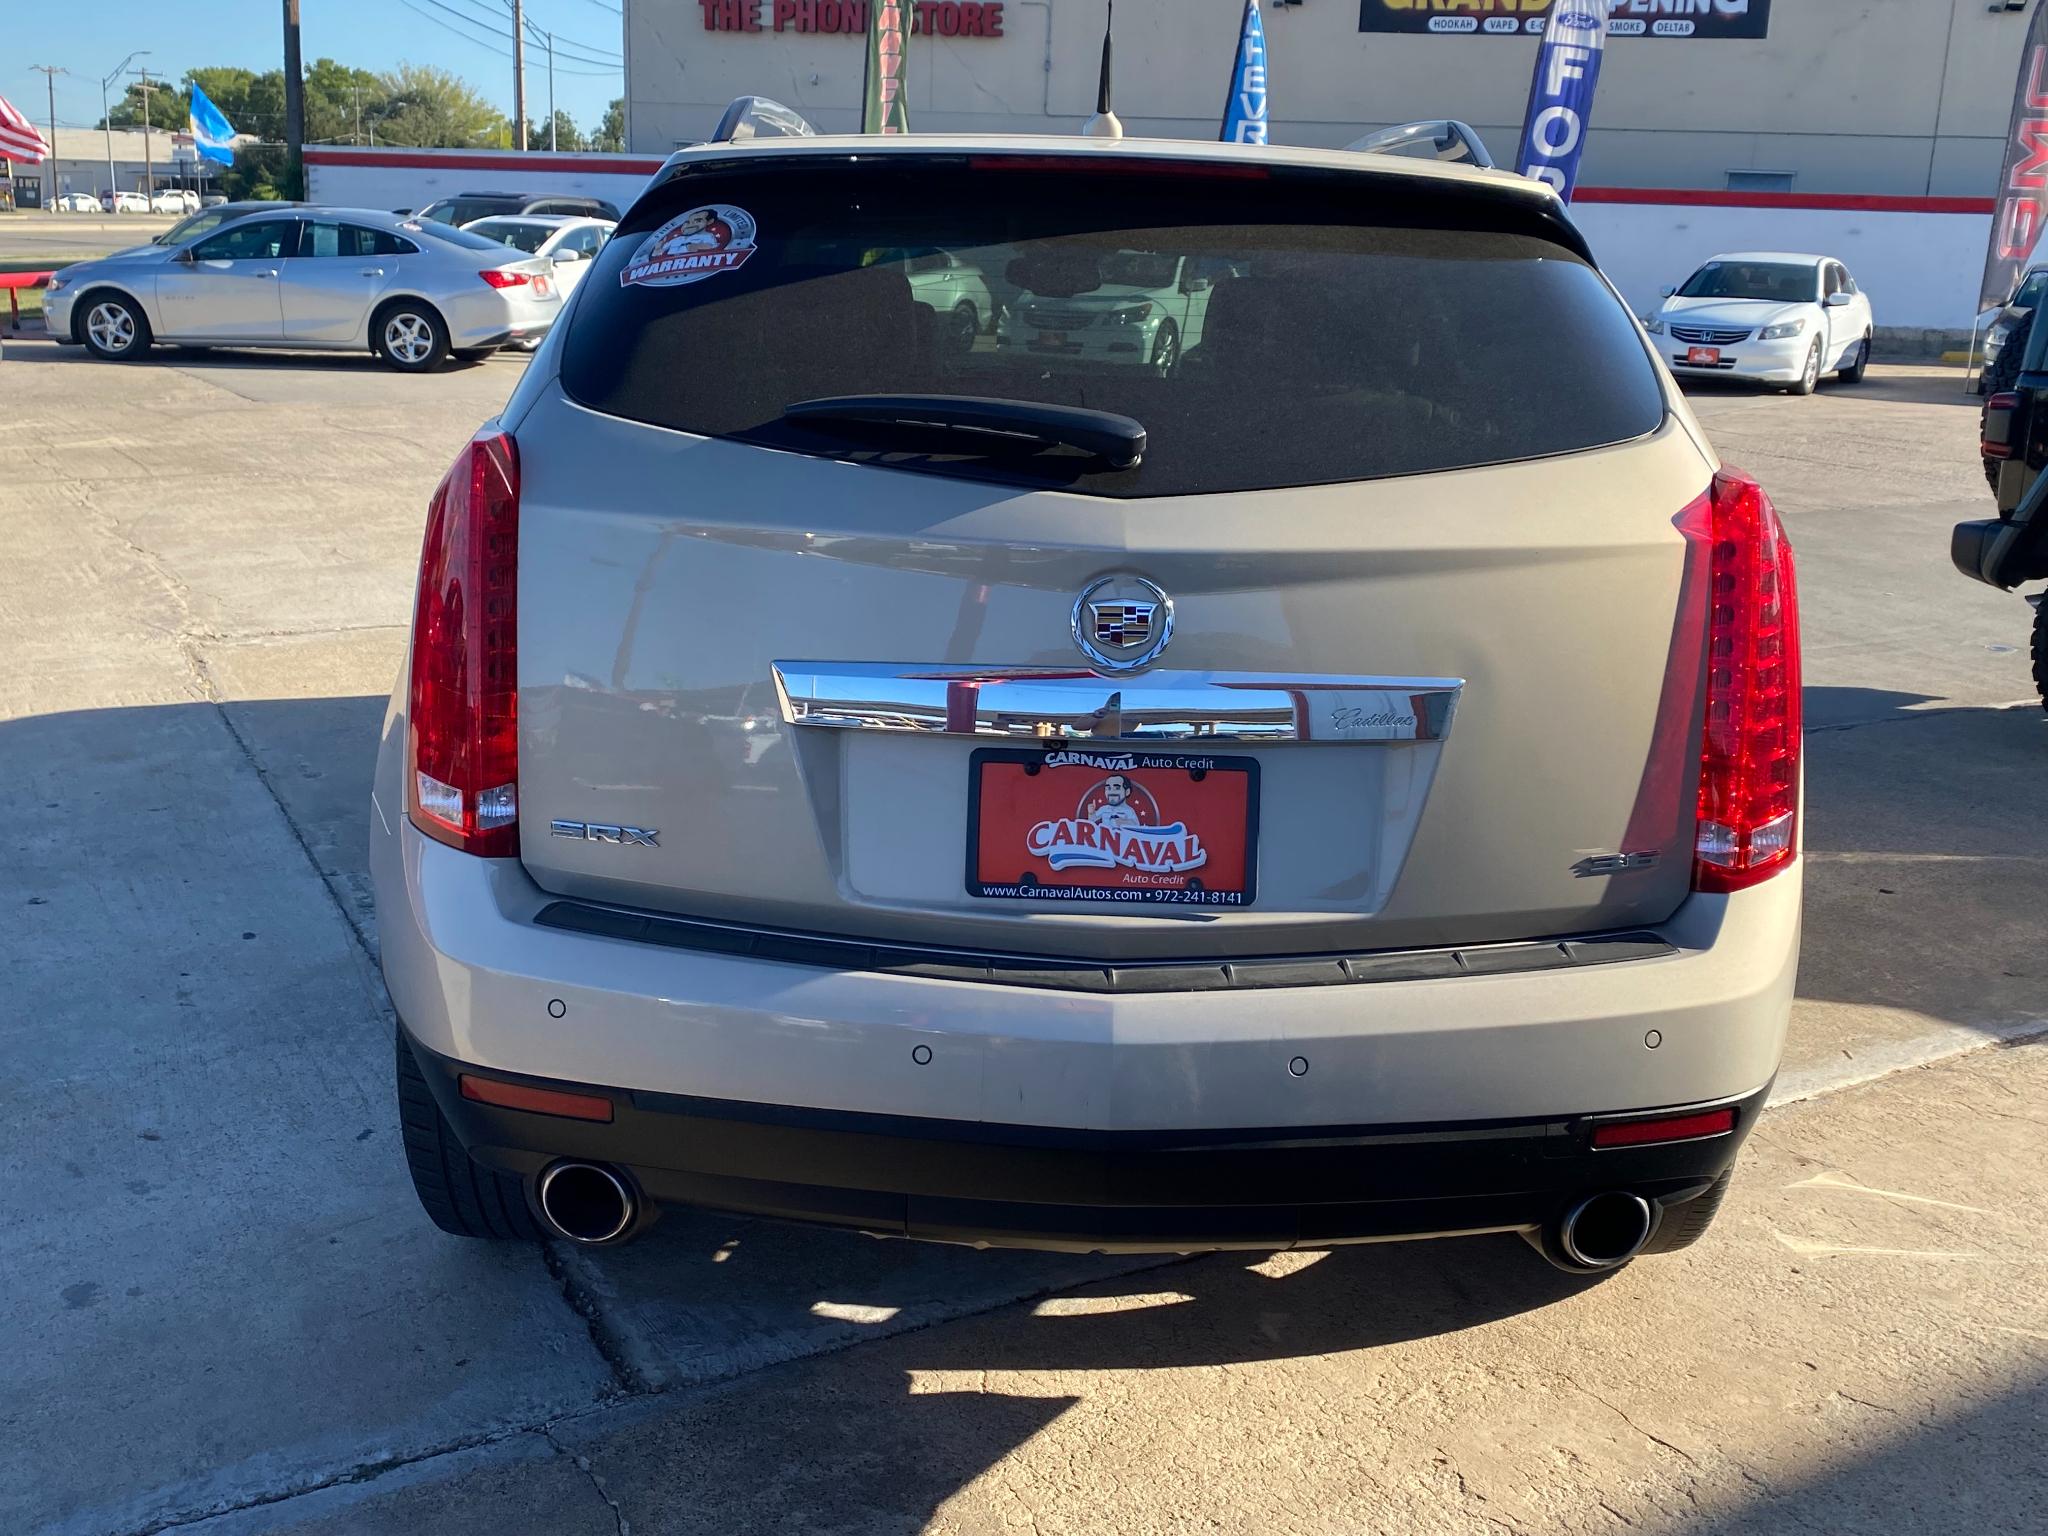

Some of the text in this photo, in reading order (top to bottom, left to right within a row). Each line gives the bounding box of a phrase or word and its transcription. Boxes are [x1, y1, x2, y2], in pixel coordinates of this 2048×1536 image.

[700, 0, 1004, 36] THE PHON TORE
[1434, 19, 1473, 29] HOOKAH
[1490, 20, 1513, 30] VAPE
[1609, 21, 1641, 32] SMOKE
[1525, 45, 1590, 197] FO
[629, 252, 739, 280] WARRANTY
[1331, 707, 1415, 730] Cadillac
[1044, 752, 1214, 770] CARNAVAL Auto Credit
[551, 820, 660, 848] SRX
[1027, 820, 1205, 867] CARNAVAL
[1122, 873, 1184, 885] Auto Credit
[983, 885, 1242, 904] www.CarnavalAutos.com 972-241-8141
